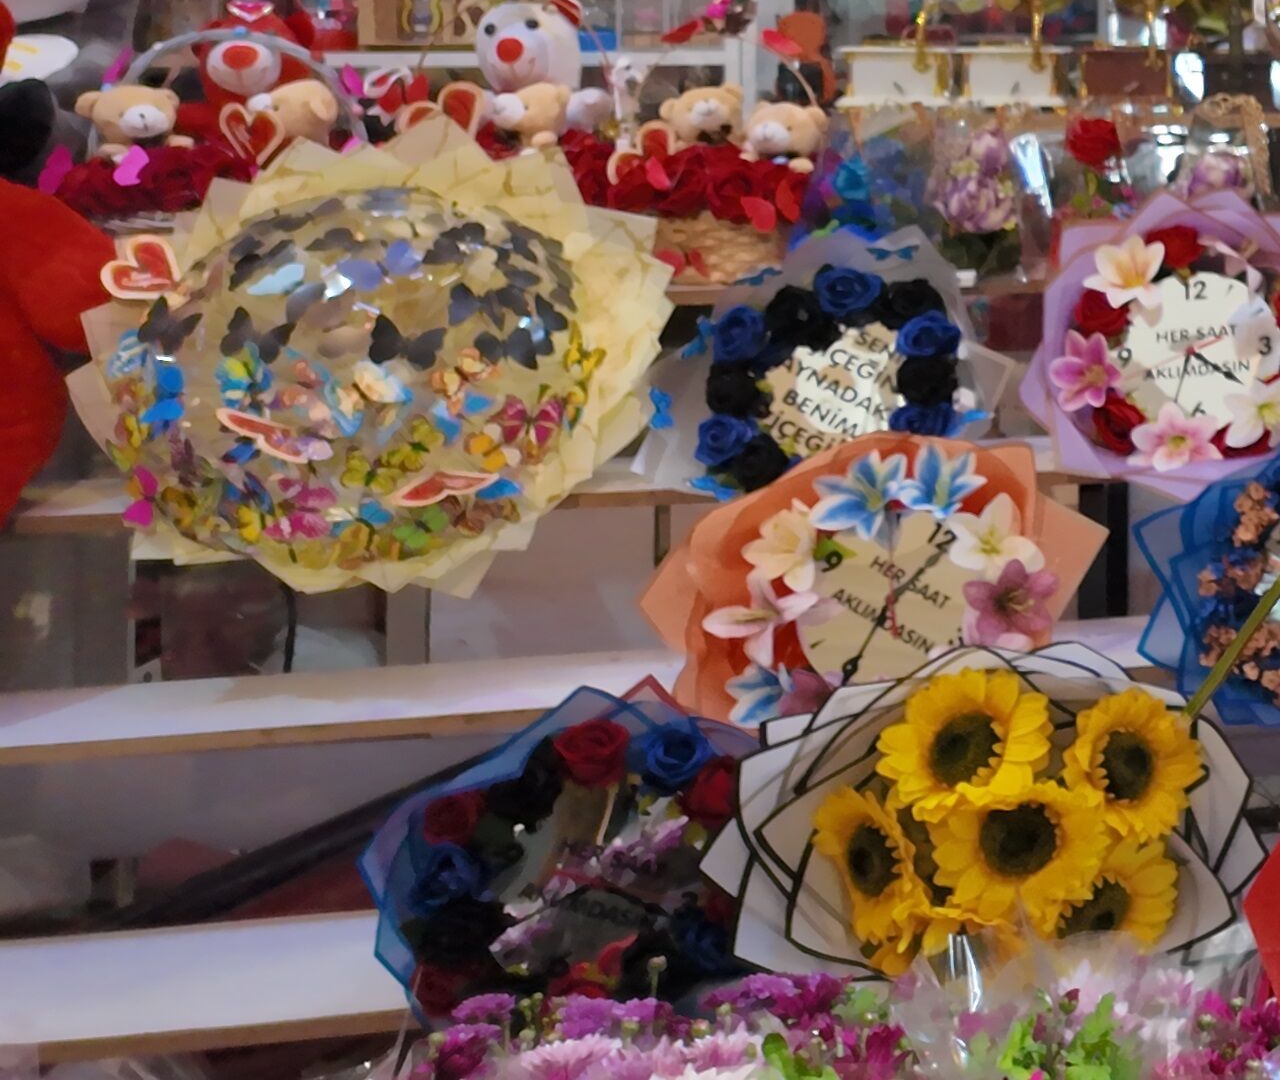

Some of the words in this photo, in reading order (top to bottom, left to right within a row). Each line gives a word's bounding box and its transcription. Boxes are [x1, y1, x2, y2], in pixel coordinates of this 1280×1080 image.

[1184, 280, 1209, 301] 12
[1156, 329, 1190, 344] HER
[1196, 323, 1238, 340] SAAT
[1258, 336, 1272, 356] 3
[1117, 348, 1132, 368] 9
[926, 521, 957, 552] 12
[821, 550, 843, 572] 9
[869, 555, 906, 582] HER
[907, 577, 952, 609] SAAT
